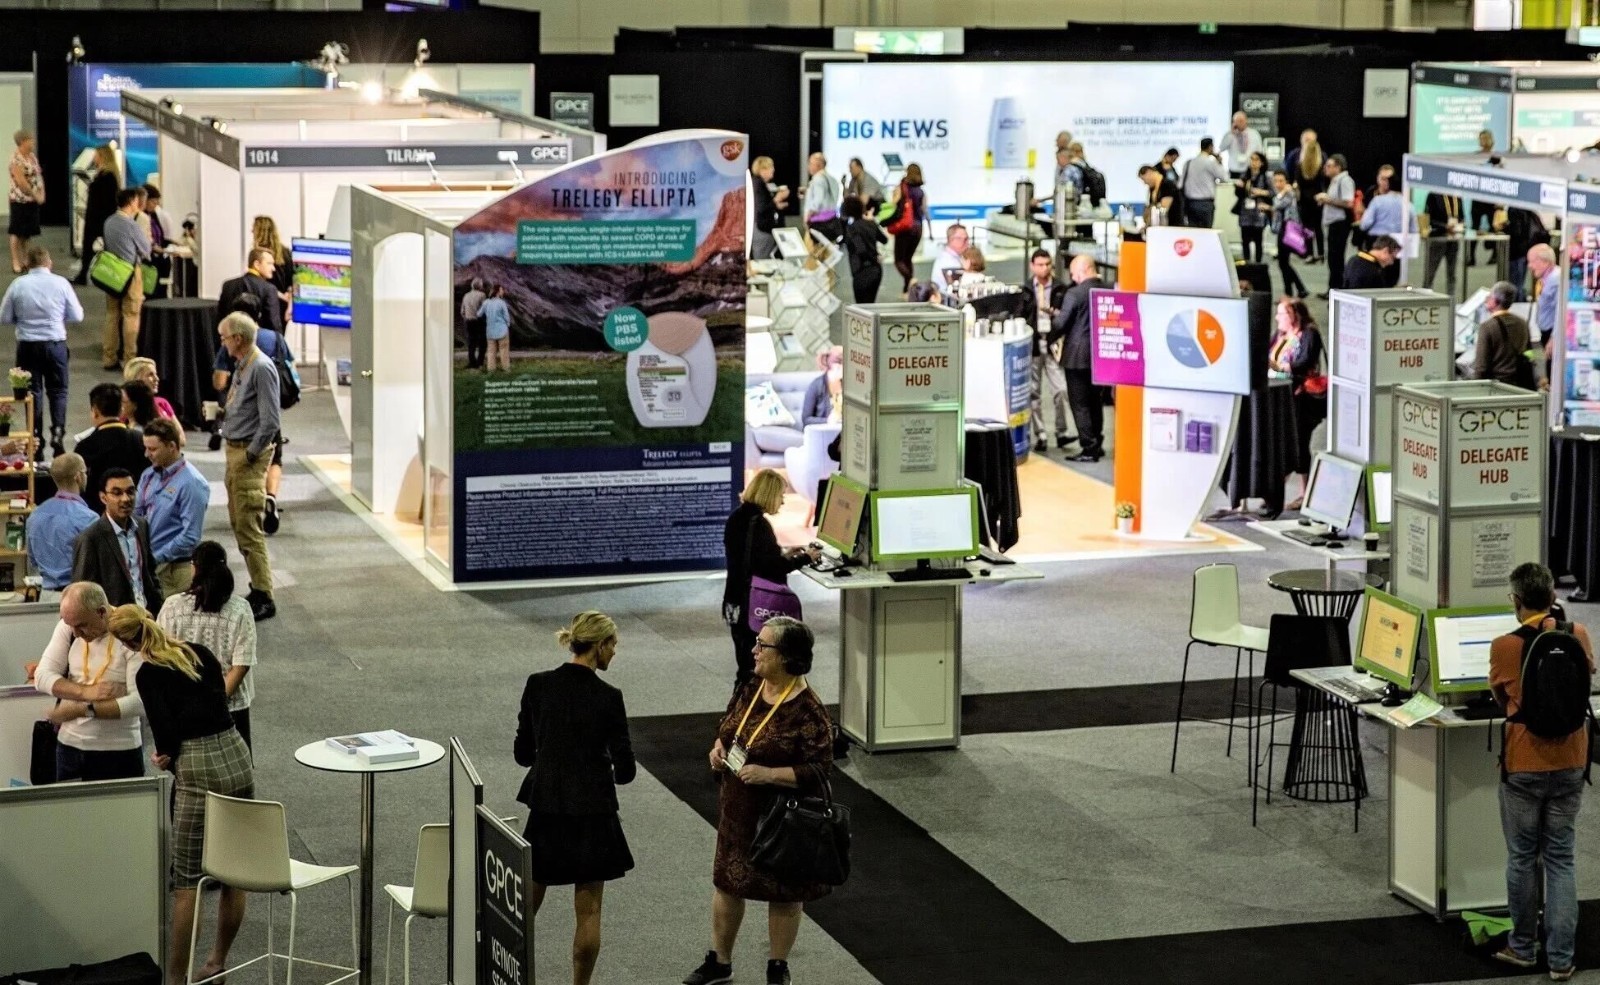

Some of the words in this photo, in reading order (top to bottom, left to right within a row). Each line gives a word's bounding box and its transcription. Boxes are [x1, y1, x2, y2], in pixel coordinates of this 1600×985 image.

[555, 99, 589, 113] GPCE
[1243, 99, 1274, 112] GPCE
[838, 120, 873, 139] BIG
[881, 120, 948, 138] NEWS
[905, 141, 916, 150] IN
[919, 140, 949, 151] COPD
[249, 150, 280, 164] 1014
[531, 147, 567, 160] GPCE
[614, 171, 696, 186] INTRODUCING
[1447, 171, 1480, 190] PROPERTY
[1480, 176, 1519, 196] INVESTMENT
[551, 187, 624, 208] TRELEGY
[631, 187, 696, 207] ELLIPTA
[522, 234, 550, 243] patients
[568, 234, 600, 242] moderate
[614, 313, 636, 323] Now
[1383, 306, 1440, 327] GPCE
[615, 324, 638, 334] PBS
[850, 317, 872, 342] GPCE
[887, 323, 949, 343] GPCE
[614, 334, 642, 347] listed
[1384, 338, 1440, 352] DELEGATE
[850, 349, 871, 369] DELEGATE
[889, 355, 949, 370] DELEGATE
[1399, 355, 1424, 368] HUB
[855, 370, 866, 384] HUB
[905, 374, 932, 387] HUB
[1402, 400, 1438, 430] GPCE
[1459, 408, 1530, 433] GPCE
[642, 448, 679, 459] TRELEGY
[1403, 438, 1438, 461] DELEGATE
[1460, 447, 1529, 464] DELEGATE
[1412, 462, 1428, 479] HUB
[1480, 469, 1509, 484] HUB
[485, 849, 523, 921] GPCE
[491, 936, 521, 985] KEYNOTE
